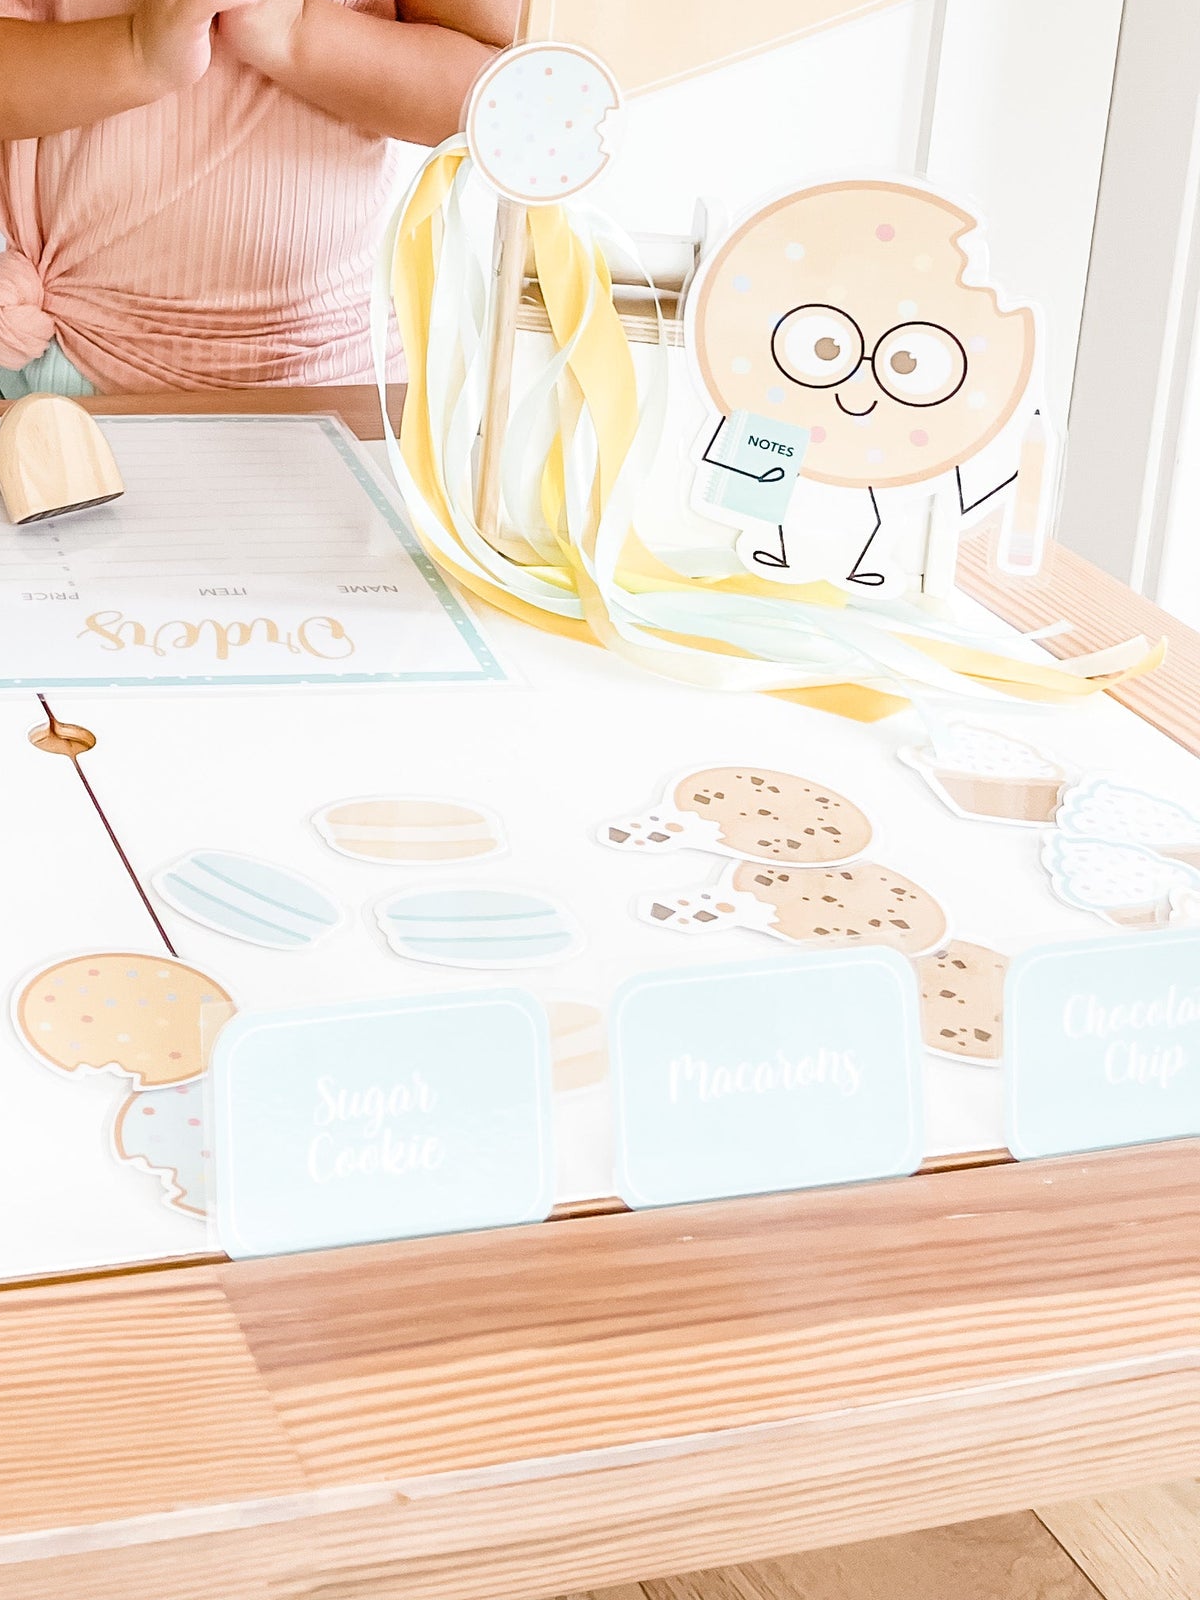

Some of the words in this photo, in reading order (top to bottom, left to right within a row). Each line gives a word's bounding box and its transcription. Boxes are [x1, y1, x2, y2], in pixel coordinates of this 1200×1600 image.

[747, 434, 795, 459] NOTES
[21, 591, 81, 601] PRICE
[199, 587, 248, 597] ITEM
[337, 584, 400, 595] NAME
[75, 609, 357, 661] Orders
[1062, 984, 1200, 1040] Chocola
[667, 1046, 866, 1105] Macarons
[1104, 1039, 1189, 1089] Chip
[312, 1069, 441, 1139] Sugar
[307, 1127, 448, 1184] Cookie
